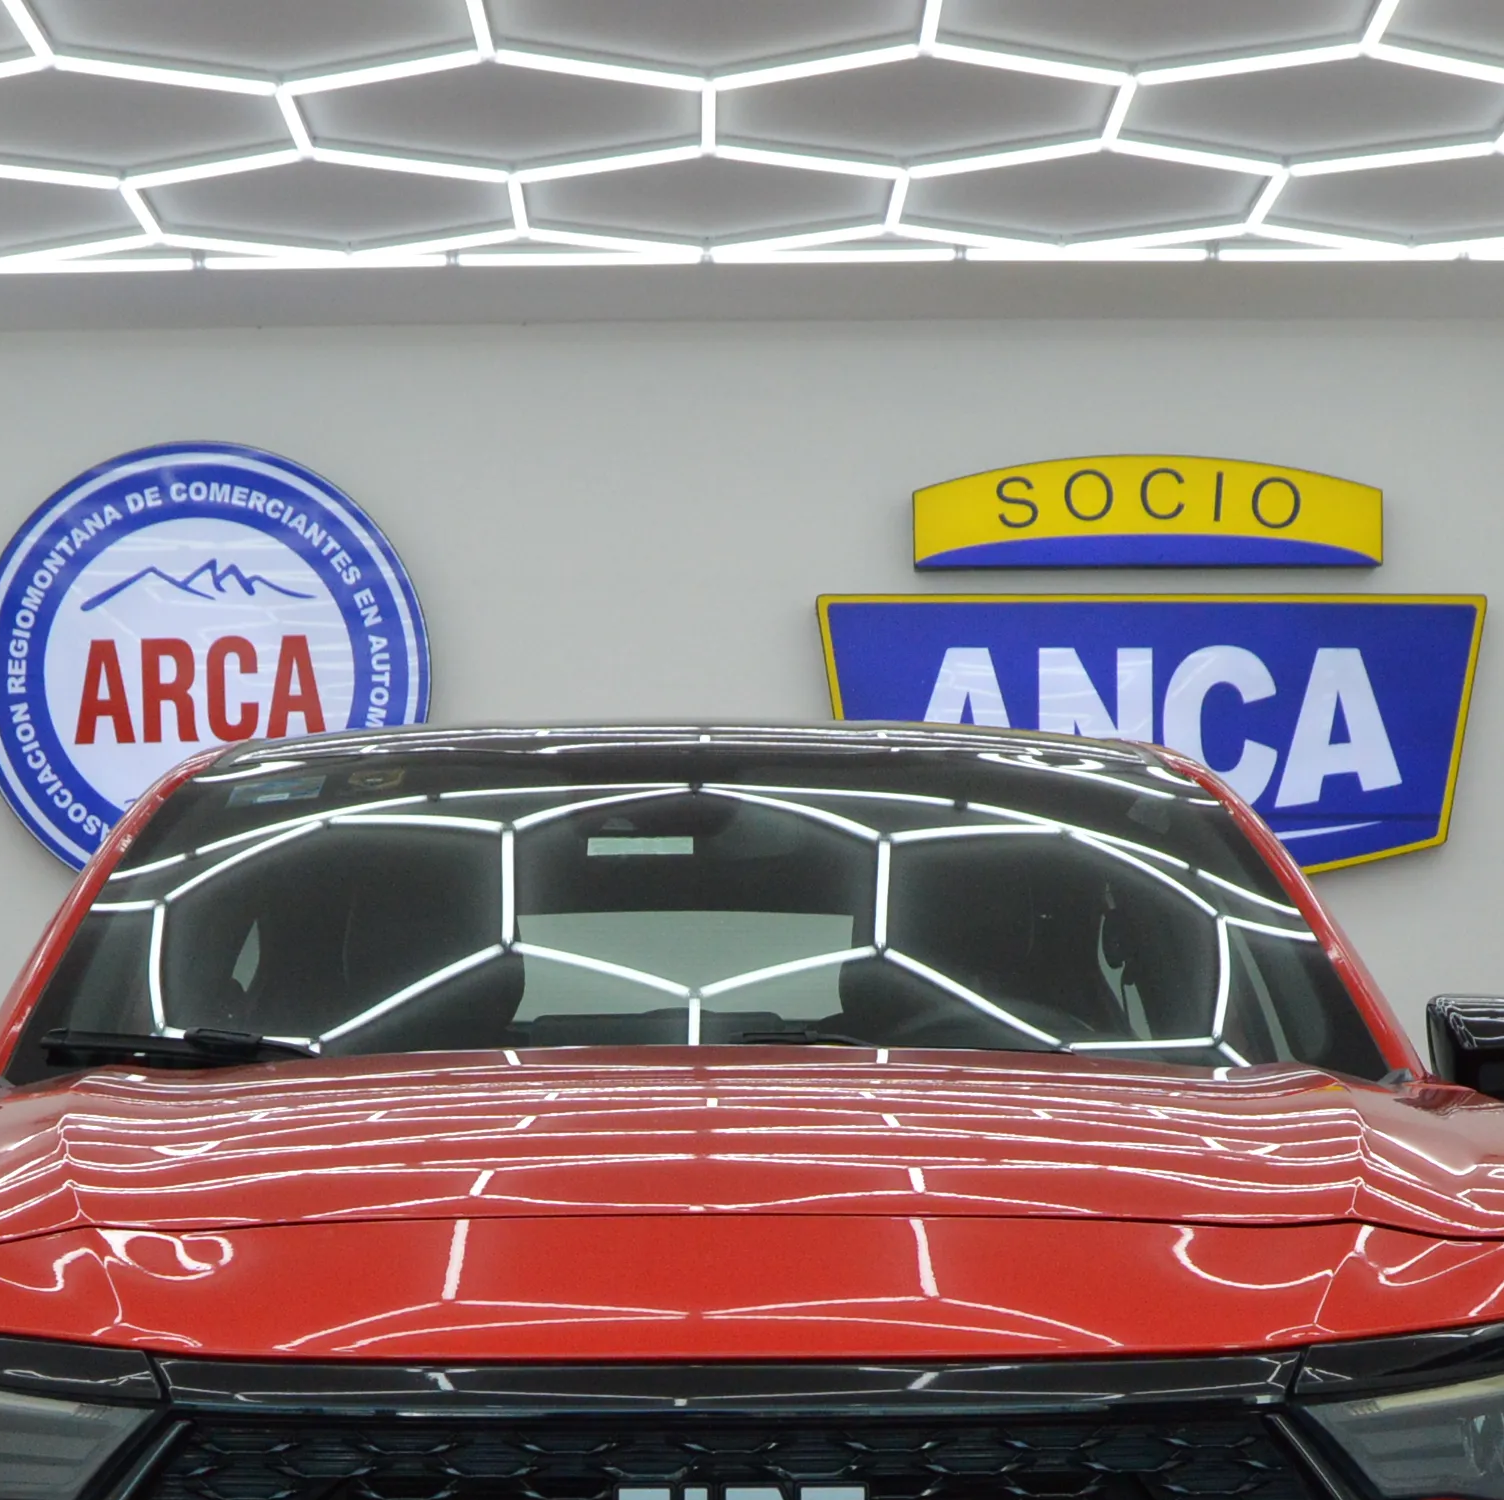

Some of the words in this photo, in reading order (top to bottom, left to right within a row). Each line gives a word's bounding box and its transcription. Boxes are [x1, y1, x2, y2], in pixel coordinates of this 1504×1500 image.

[996, 468, 1302, 529] SOCIO
[7, 505, 123, 695] REGIOMONTANA
[126, 486, 163, 514] DE
[169, 481, 361, 586] COMERCIANTES
[353, 587, 383, 628] EN
[74, 635, 327, 745] ARCA
